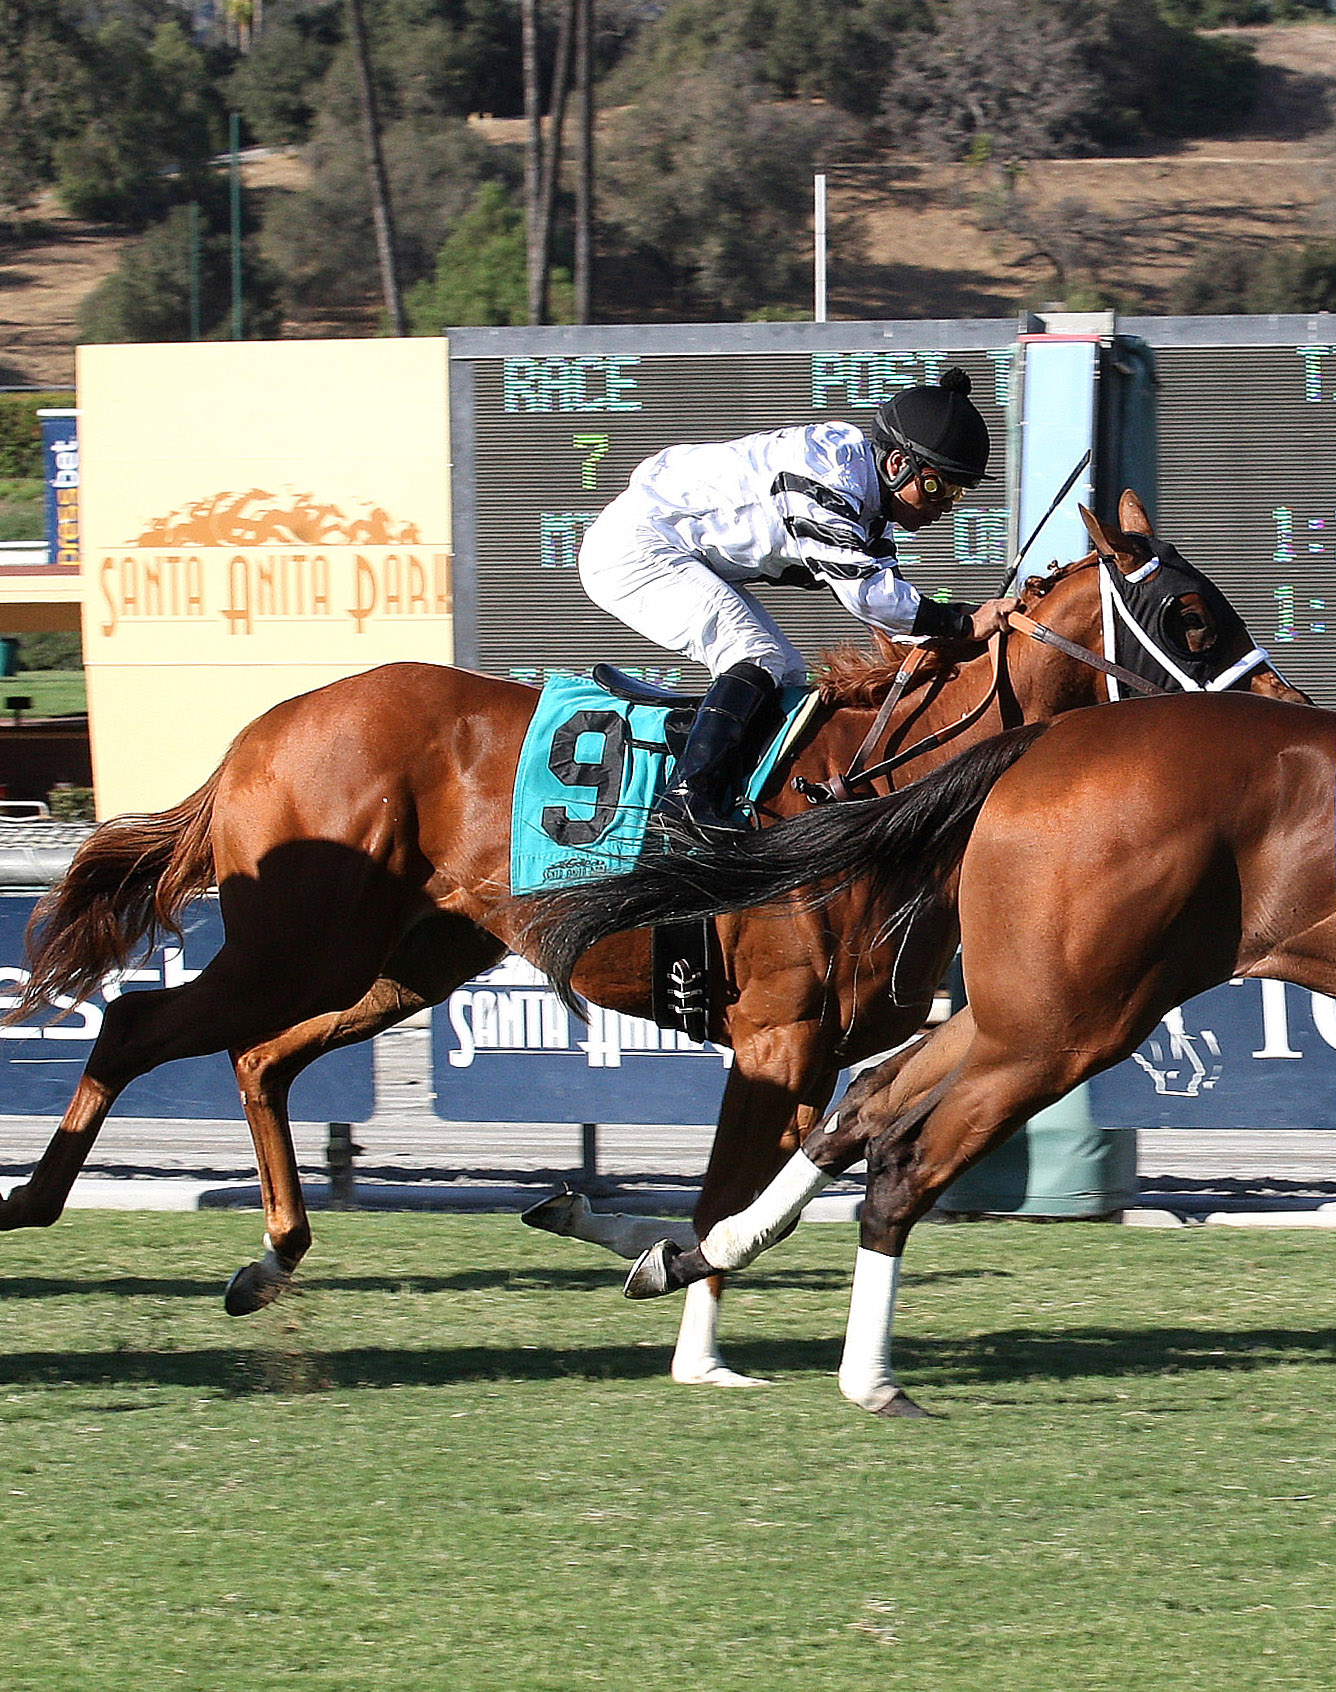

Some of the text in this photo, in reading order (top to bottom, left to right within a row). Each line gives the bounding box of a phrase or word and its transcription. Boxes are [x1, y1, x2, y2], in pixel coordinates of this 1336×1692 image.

[503, 355, 642, 412] RACE
[573, 433, 609, 490] 7
[101, 556, 205, 637] SANTA
[218, 555, 323, 635] ANITA
[541, 709, 627, 846] 9
[449, 988, 569, 1068] SANTA
